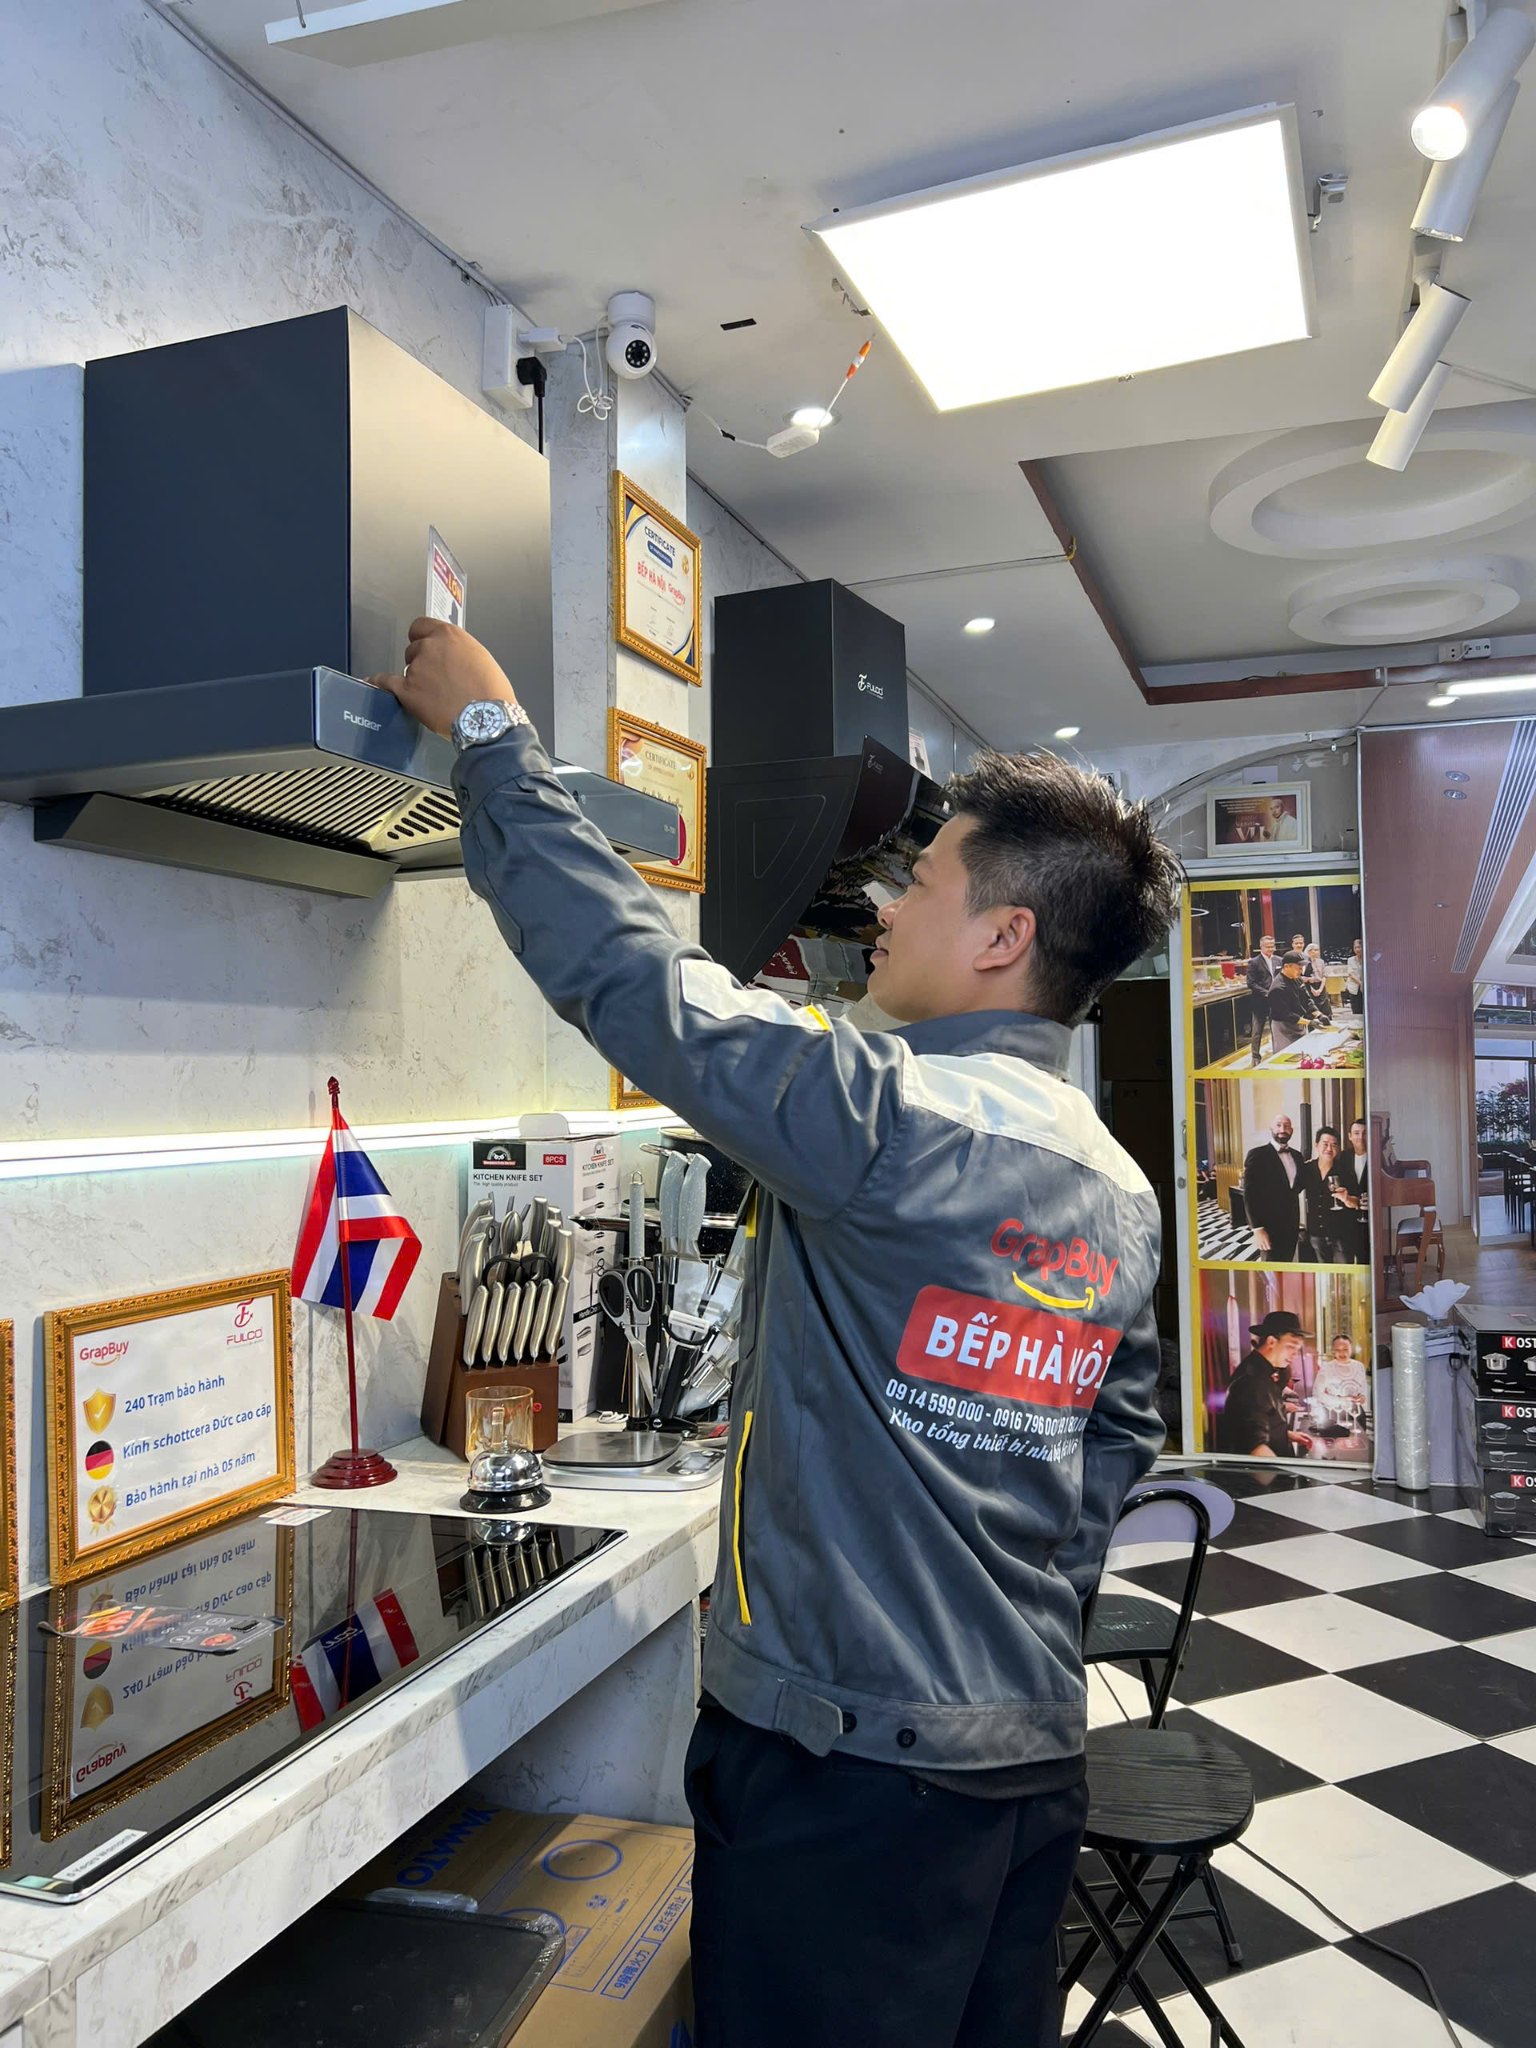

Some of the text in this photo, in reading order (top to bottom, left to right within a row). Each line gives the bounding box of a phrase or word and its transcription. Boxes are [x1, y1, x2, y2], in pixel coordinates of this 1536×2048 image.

[644, 525, 676, 557] CERTIFICATE
[645, 750, 676, 770] CERTIFICATE
[545, 1156, 564, 1164] 8PCS
[990, 1218, 1118, 1296] GrapBuy
[79, 1340, 129, 1361] GrapBuy
[226, 1328, 263, 1345] FULCO
[925, 1311, 1012, 1370] BẾP
[1015, 1330, 1065, 1385] HÀ
[125, 1375, 225, 1413] 240 Trạm bảo hành
[123, 1403, 272, 1459] Kính schottcera Đức cao cấp
[889, 1407, 923, 1435] Kho
[927, 1420, 968, 1451] tổng
[973, 1431, 1011, 1452] thiết
[1008, 1437, 1028, 1457] bị
[126, 1451, 255, 1507] Bảo hành tại nhà 05 năm
